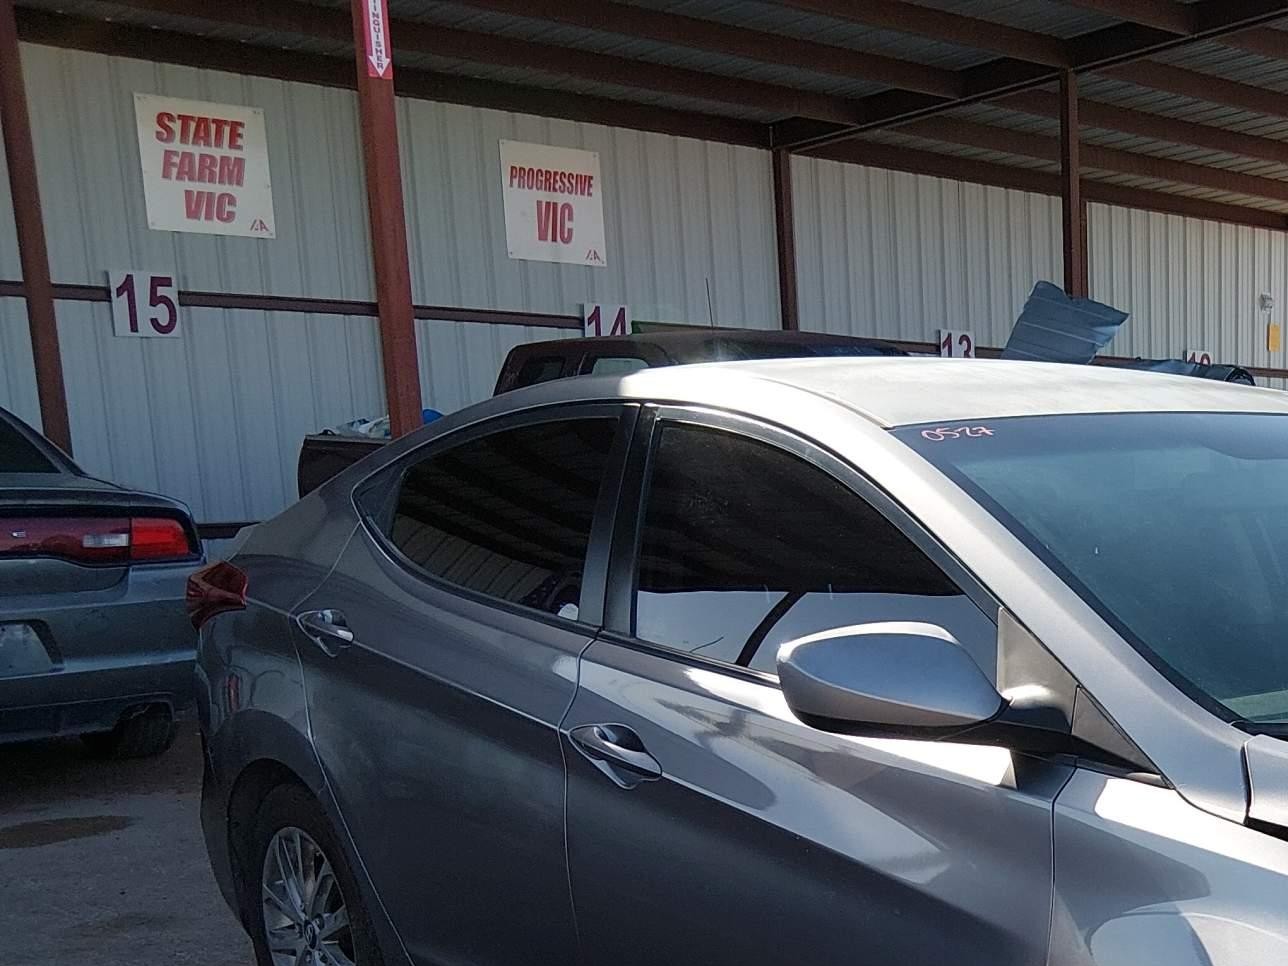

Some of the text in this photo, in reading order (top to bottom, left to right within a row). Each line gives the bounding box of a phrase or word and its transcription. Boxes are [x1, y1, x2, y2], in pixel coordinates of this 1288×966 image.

[155, 111, 245, 151] STATE
[161, 149, 246, 187] FARM
[509, 165, 594, 198] PROGRESSIVE
[184, 189, 237, 224] VIC
[536, 200, 574, 245] VIC
[116, 273, 178, 335] 15
[587, 305, 627, 336] 14
